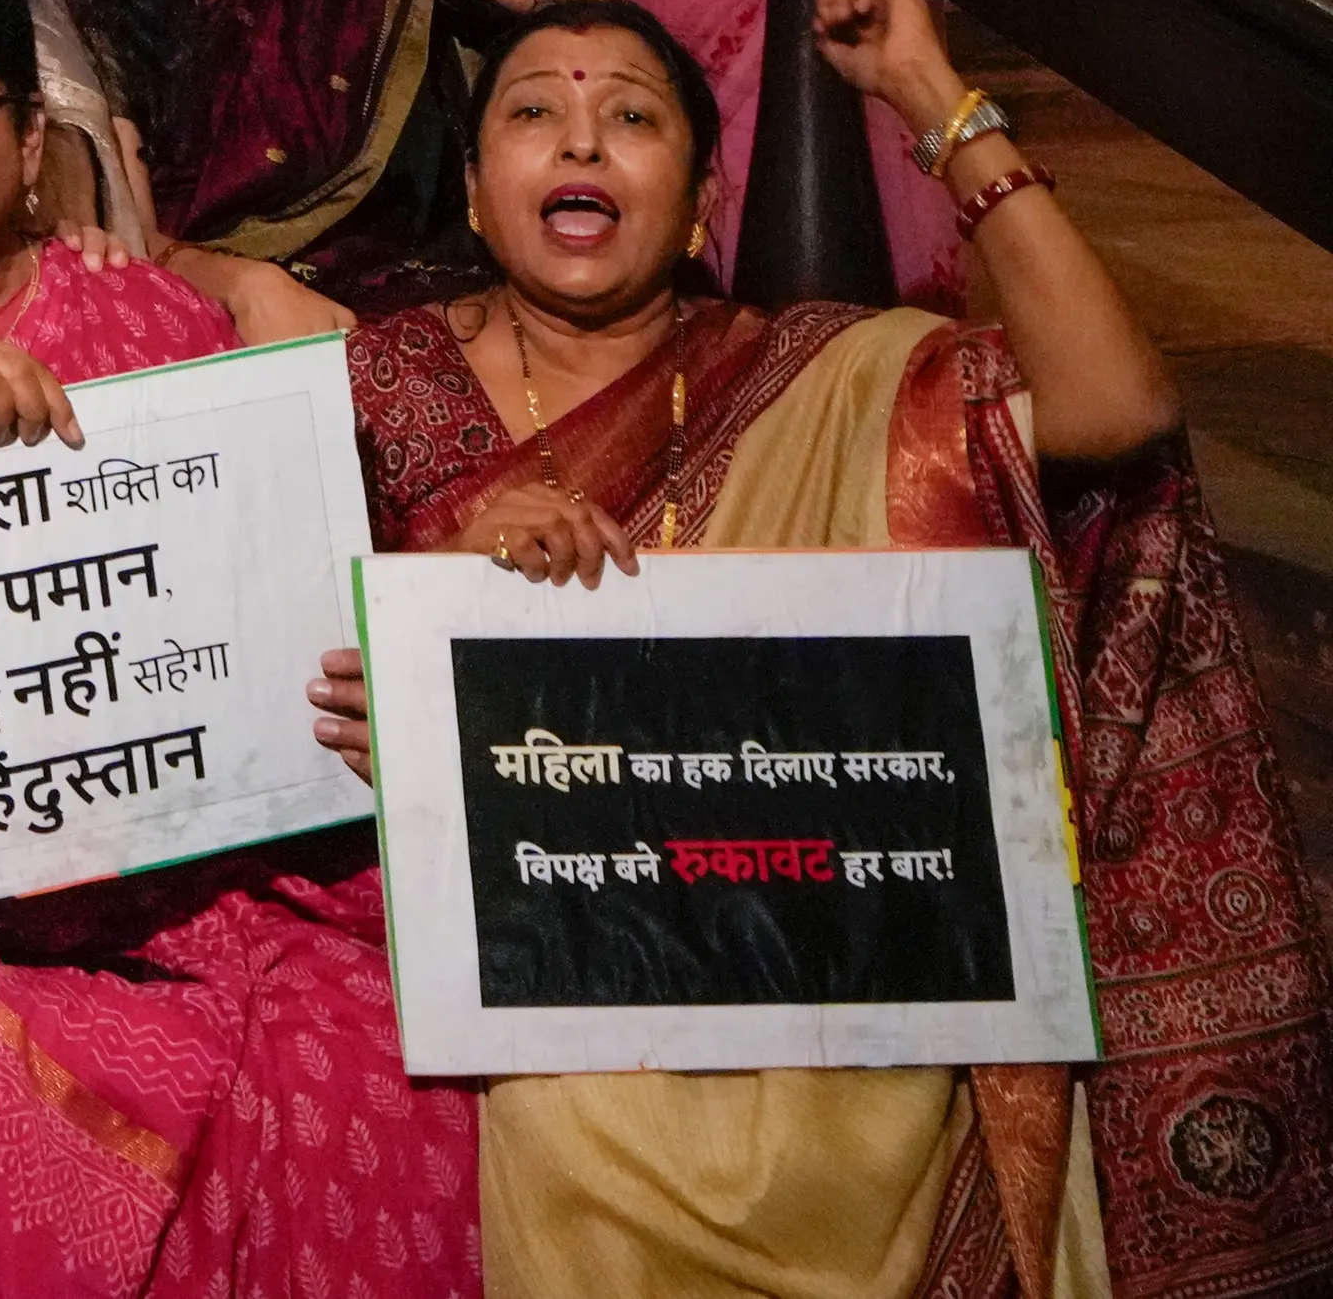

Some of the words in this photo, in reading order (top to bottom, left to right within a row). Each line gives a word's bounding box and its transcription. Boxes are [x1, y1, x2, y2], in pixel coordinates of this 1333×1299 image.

[60, 457, 160, 515] शक्ति
[170, 451, 221, 495] का
[6, 630, 121, 718] नहीं
[127, 638, 231, 697] सहेगा
[490, 728, 623, 793] महिला
[628, 751, 673, 784] का
[679, 753, 733, 790] हक
[740, 739, 839, 788] दिलाए
[840, 749, 956, 786] सरकार,
[515, 842, 606, 892] विपक्ष
[611, 842, 662, 885] बने
[665, 838, 834, 885] रुकावट
[839, 849, 885, 887] हर
[890, 848, 952, 884] बार!
